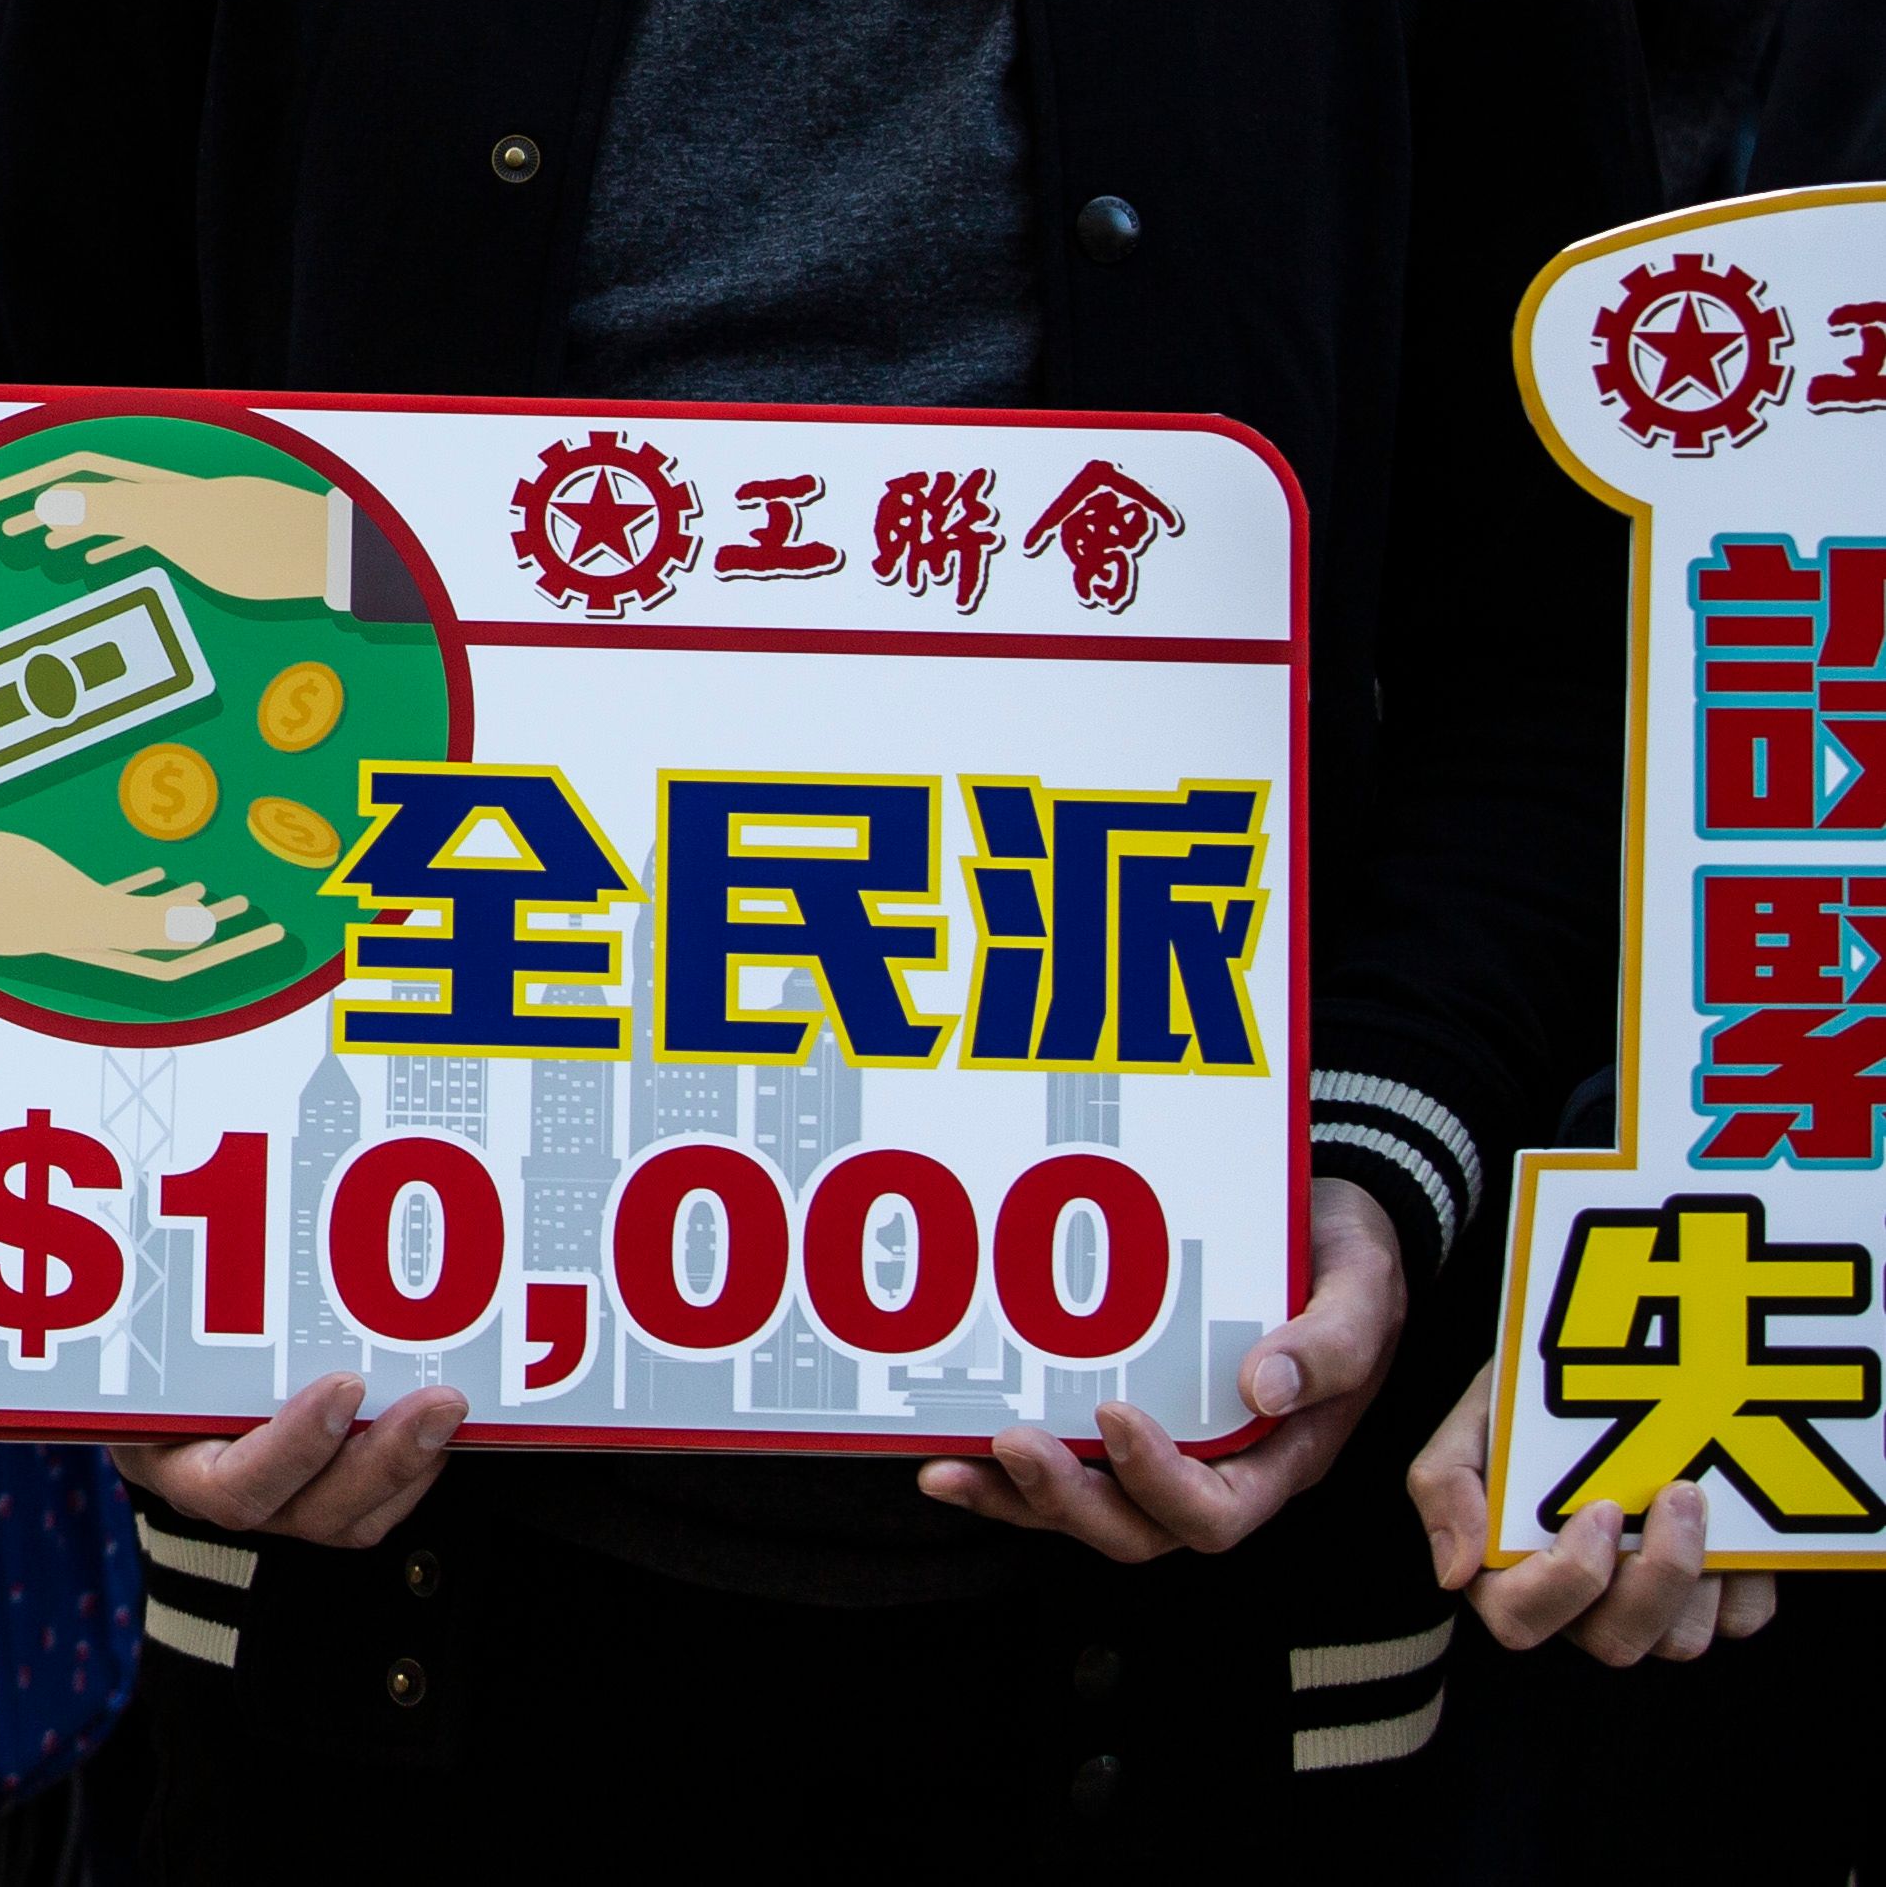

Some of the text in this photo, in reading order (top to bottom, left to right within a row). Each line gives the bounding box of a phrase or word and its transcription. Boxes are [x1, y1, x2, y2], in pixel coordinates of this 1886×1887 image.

[713, 460, 1185, 615] 工聯會
[317, 758, 1272, 1078] 全民派
